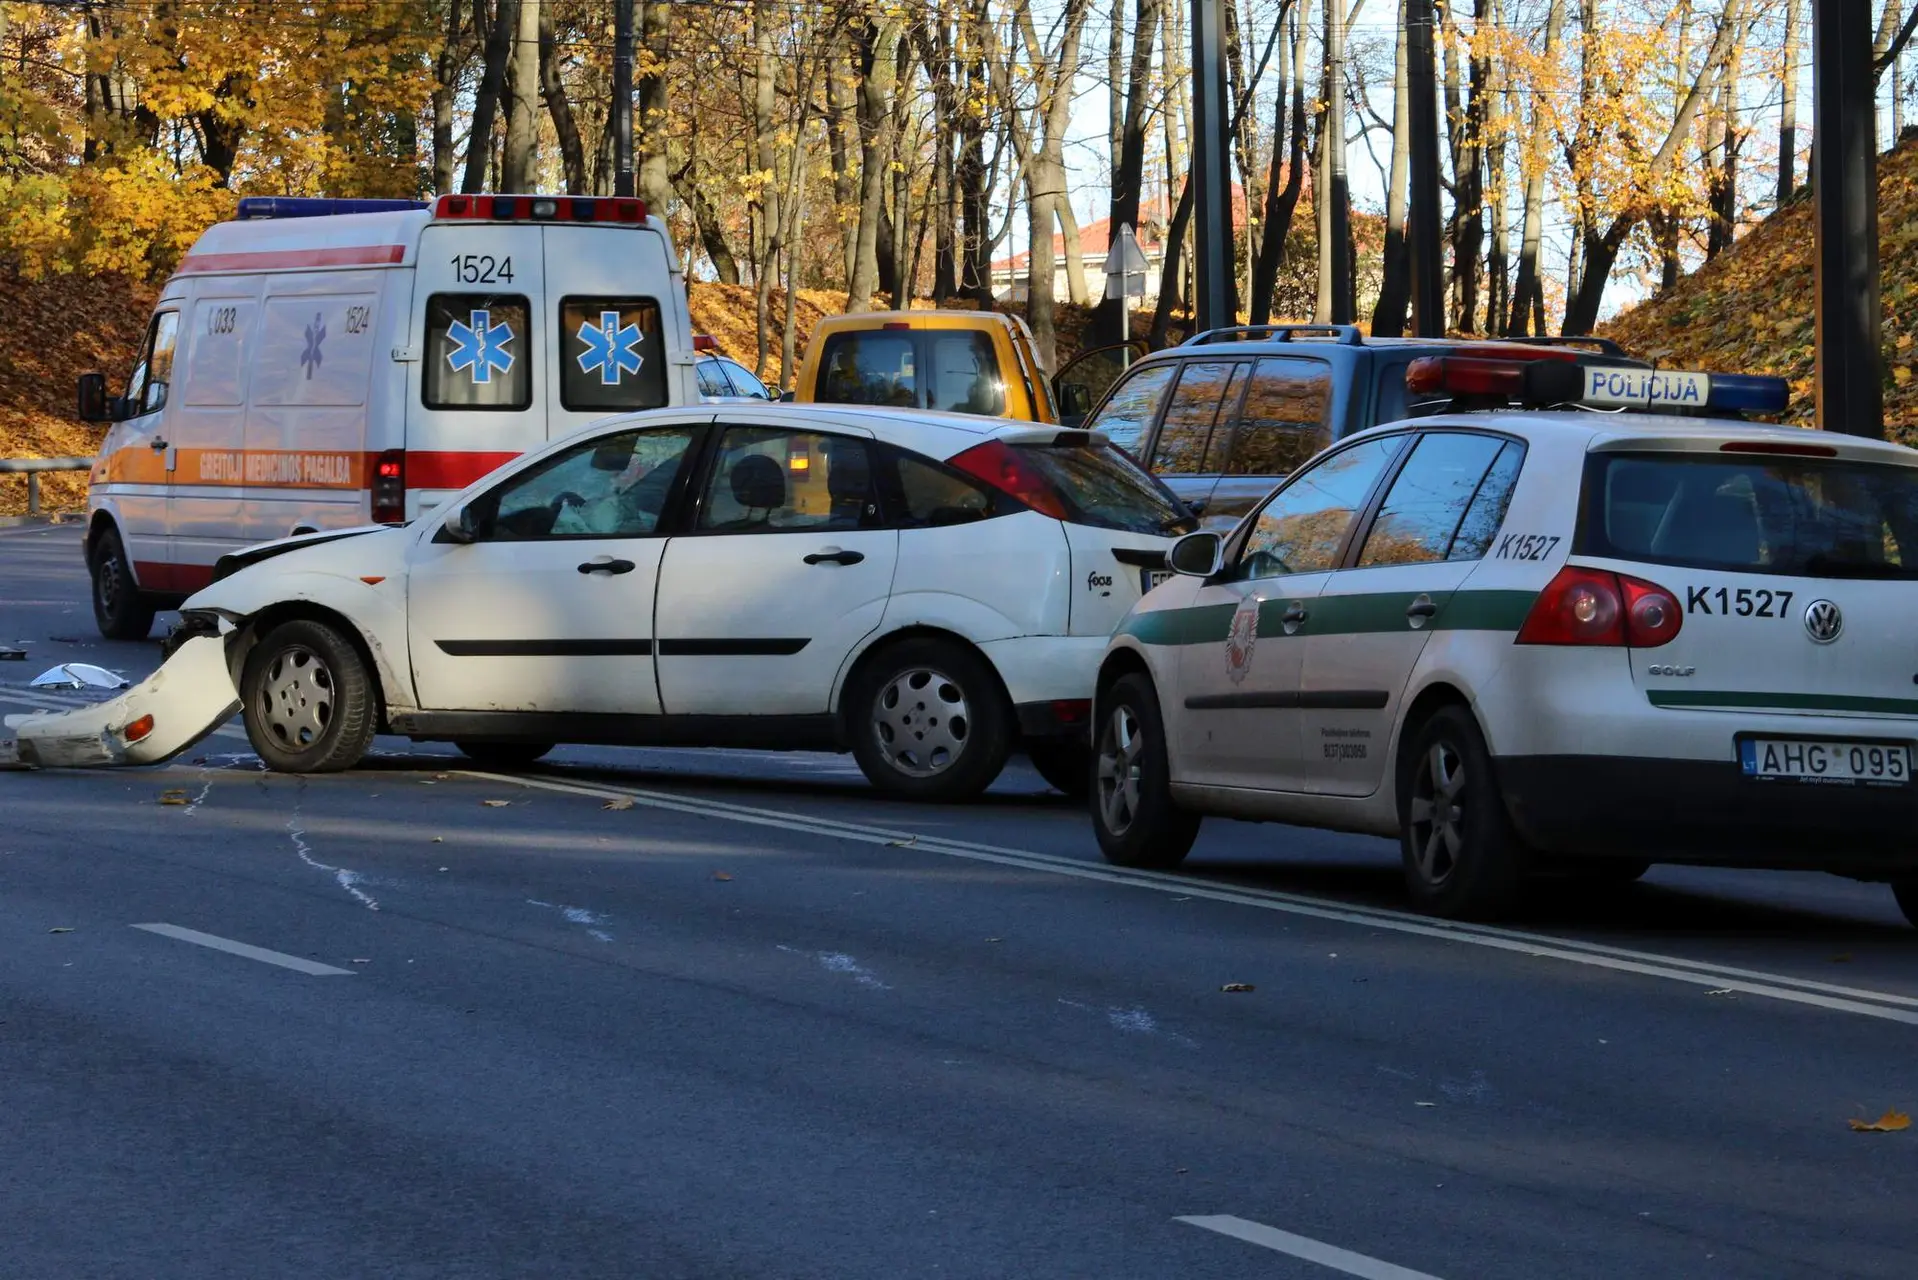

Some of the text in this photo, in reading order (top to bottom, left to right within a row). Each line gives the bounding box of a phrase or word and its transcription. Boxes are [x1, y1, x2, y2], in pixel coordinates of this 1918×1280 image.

[451, 254, 514, 284] 1524
[214, 307, 236, 334] 033
[345, 305, 370, 334] 1524
[1591, 372, 1699, 401] POLICIJA
[304, 455, 351, 484] PAGALBA
[1496, 534, 1561, 561] K1527
[1687, 586, 1794, 618] K1527
[1648, 664, 1695, 677] GOLF
[1743, 744, 1904, 778] LT AHG 095
